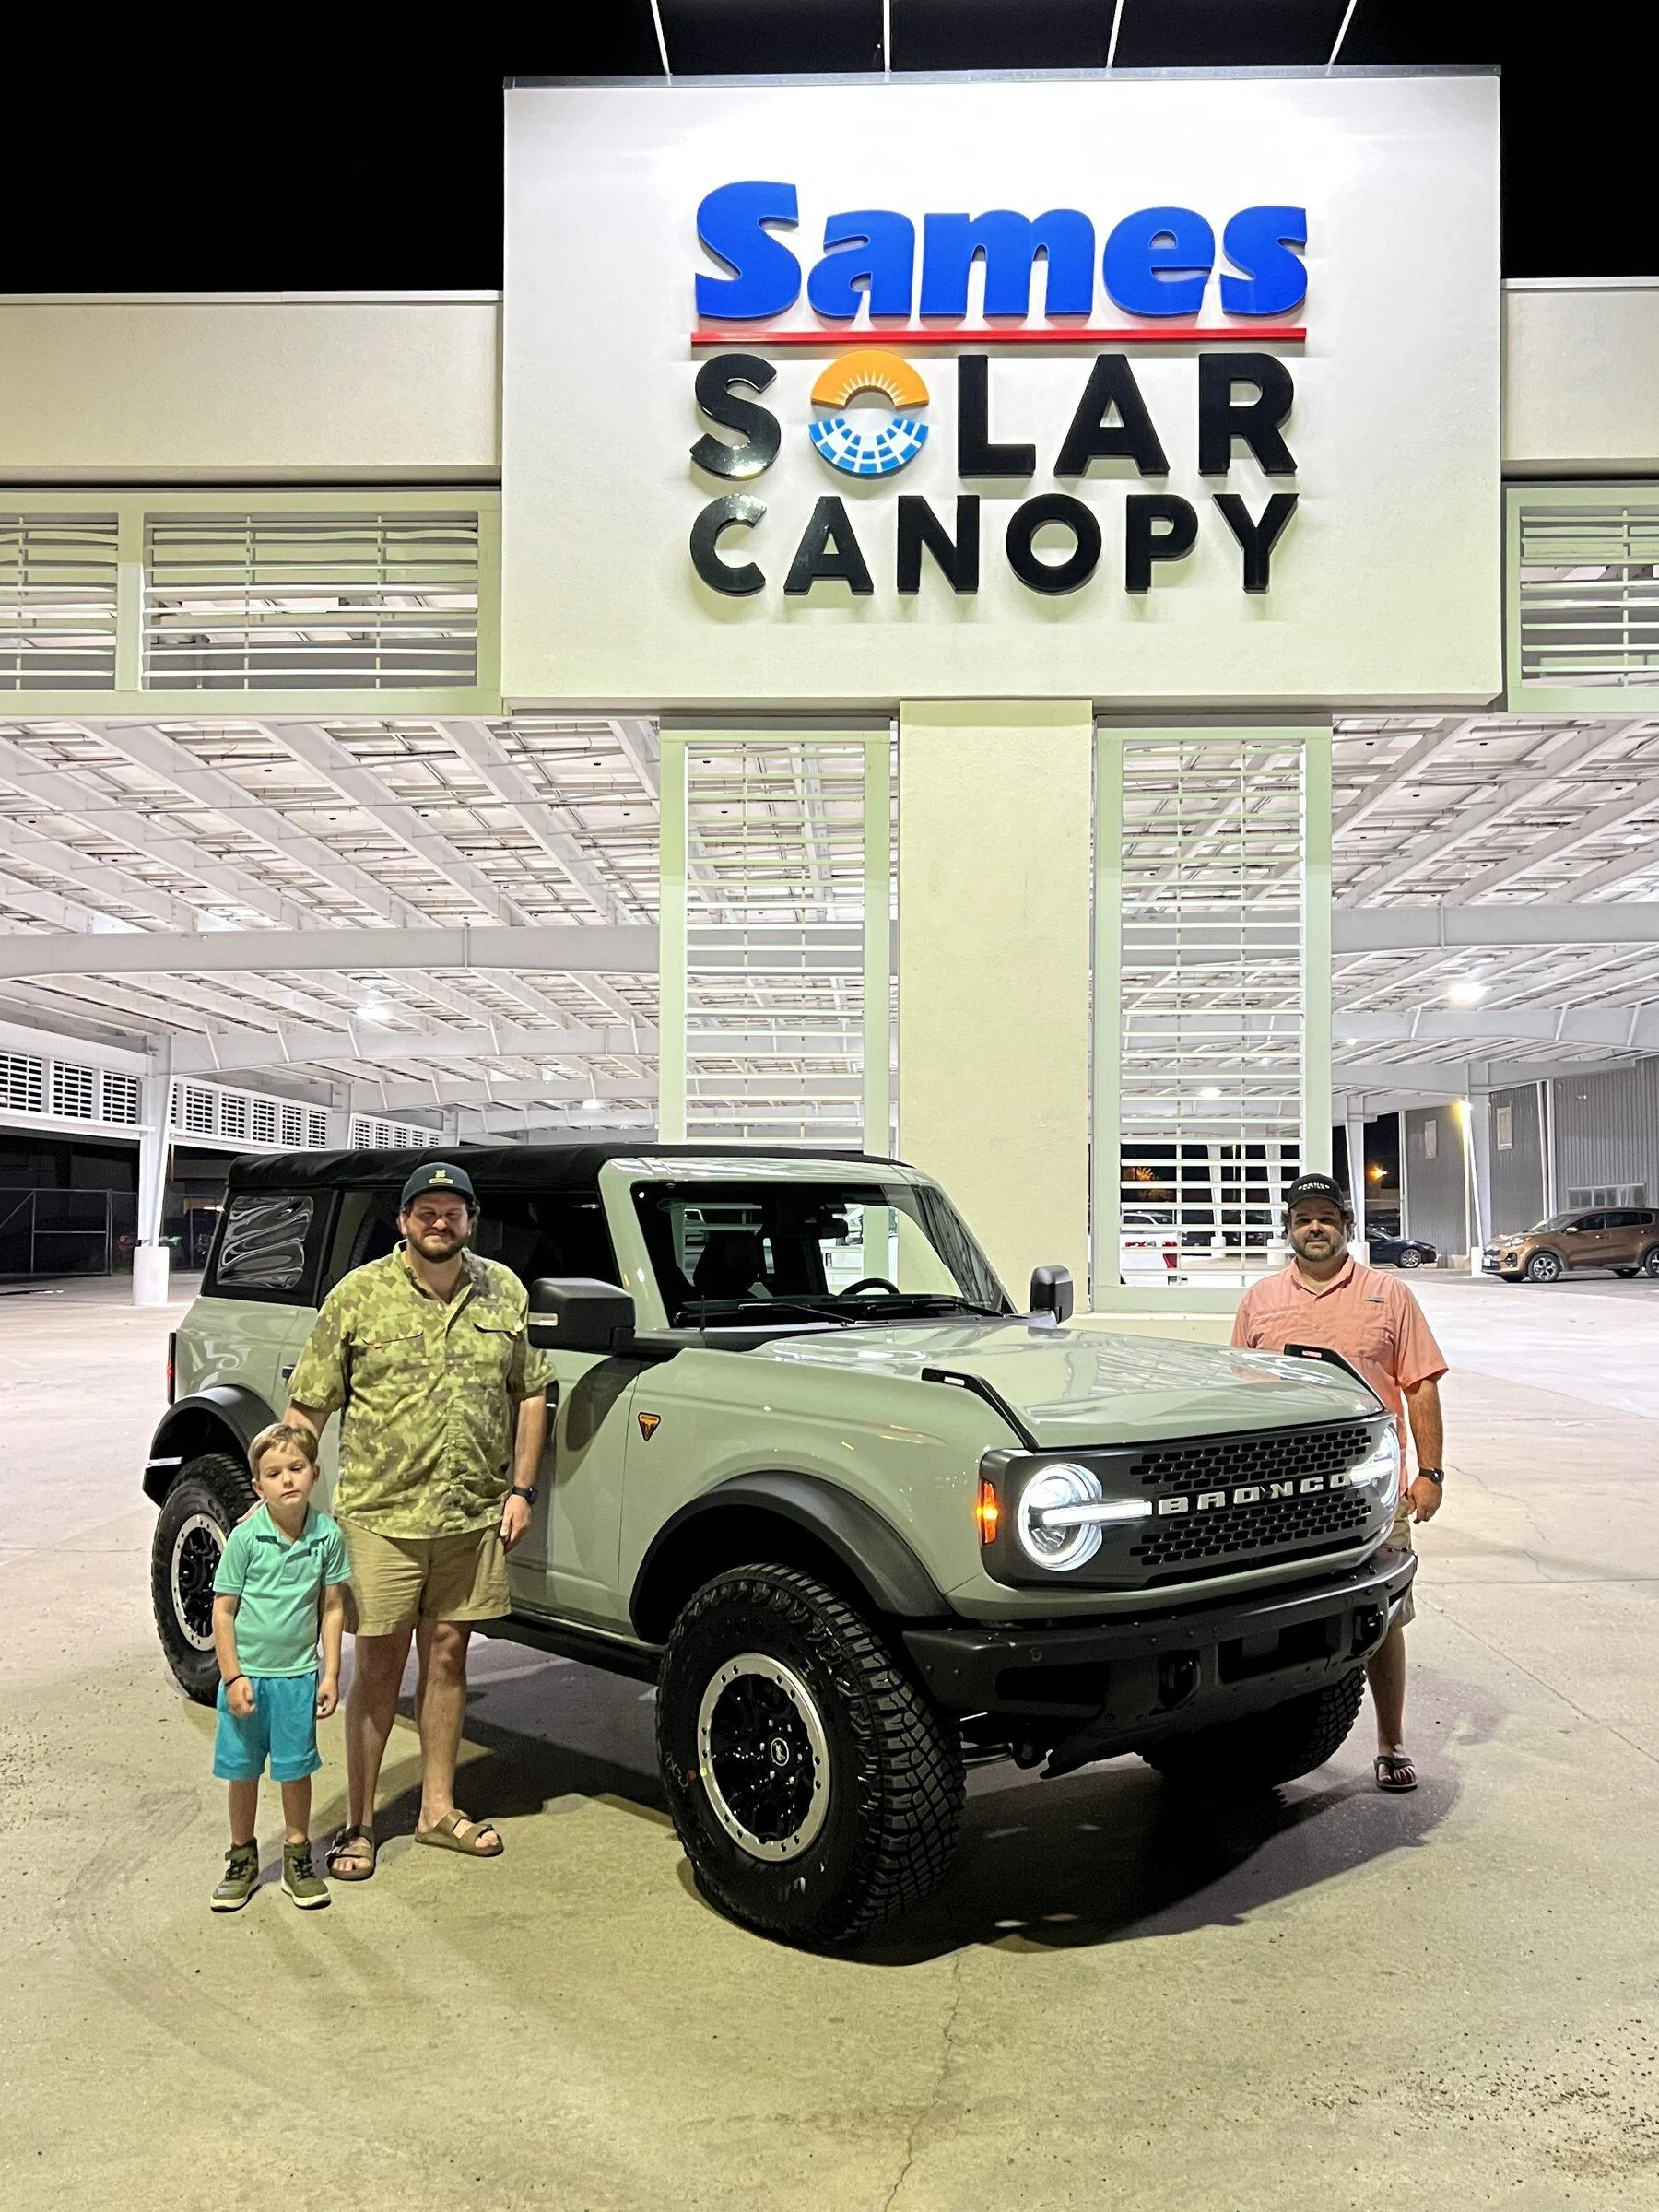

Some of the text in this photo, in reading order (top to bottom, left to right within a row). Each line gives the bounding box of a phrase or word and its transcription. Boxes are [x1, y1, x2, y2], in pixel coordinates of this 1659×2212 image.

[695, 180, 1308, 319] Sames
[689, 349, 1297, 479] SOLAR
[689, 493, 1300, 596] CANOPY
[1158, 1472, 1351, 1515] BRONCO
